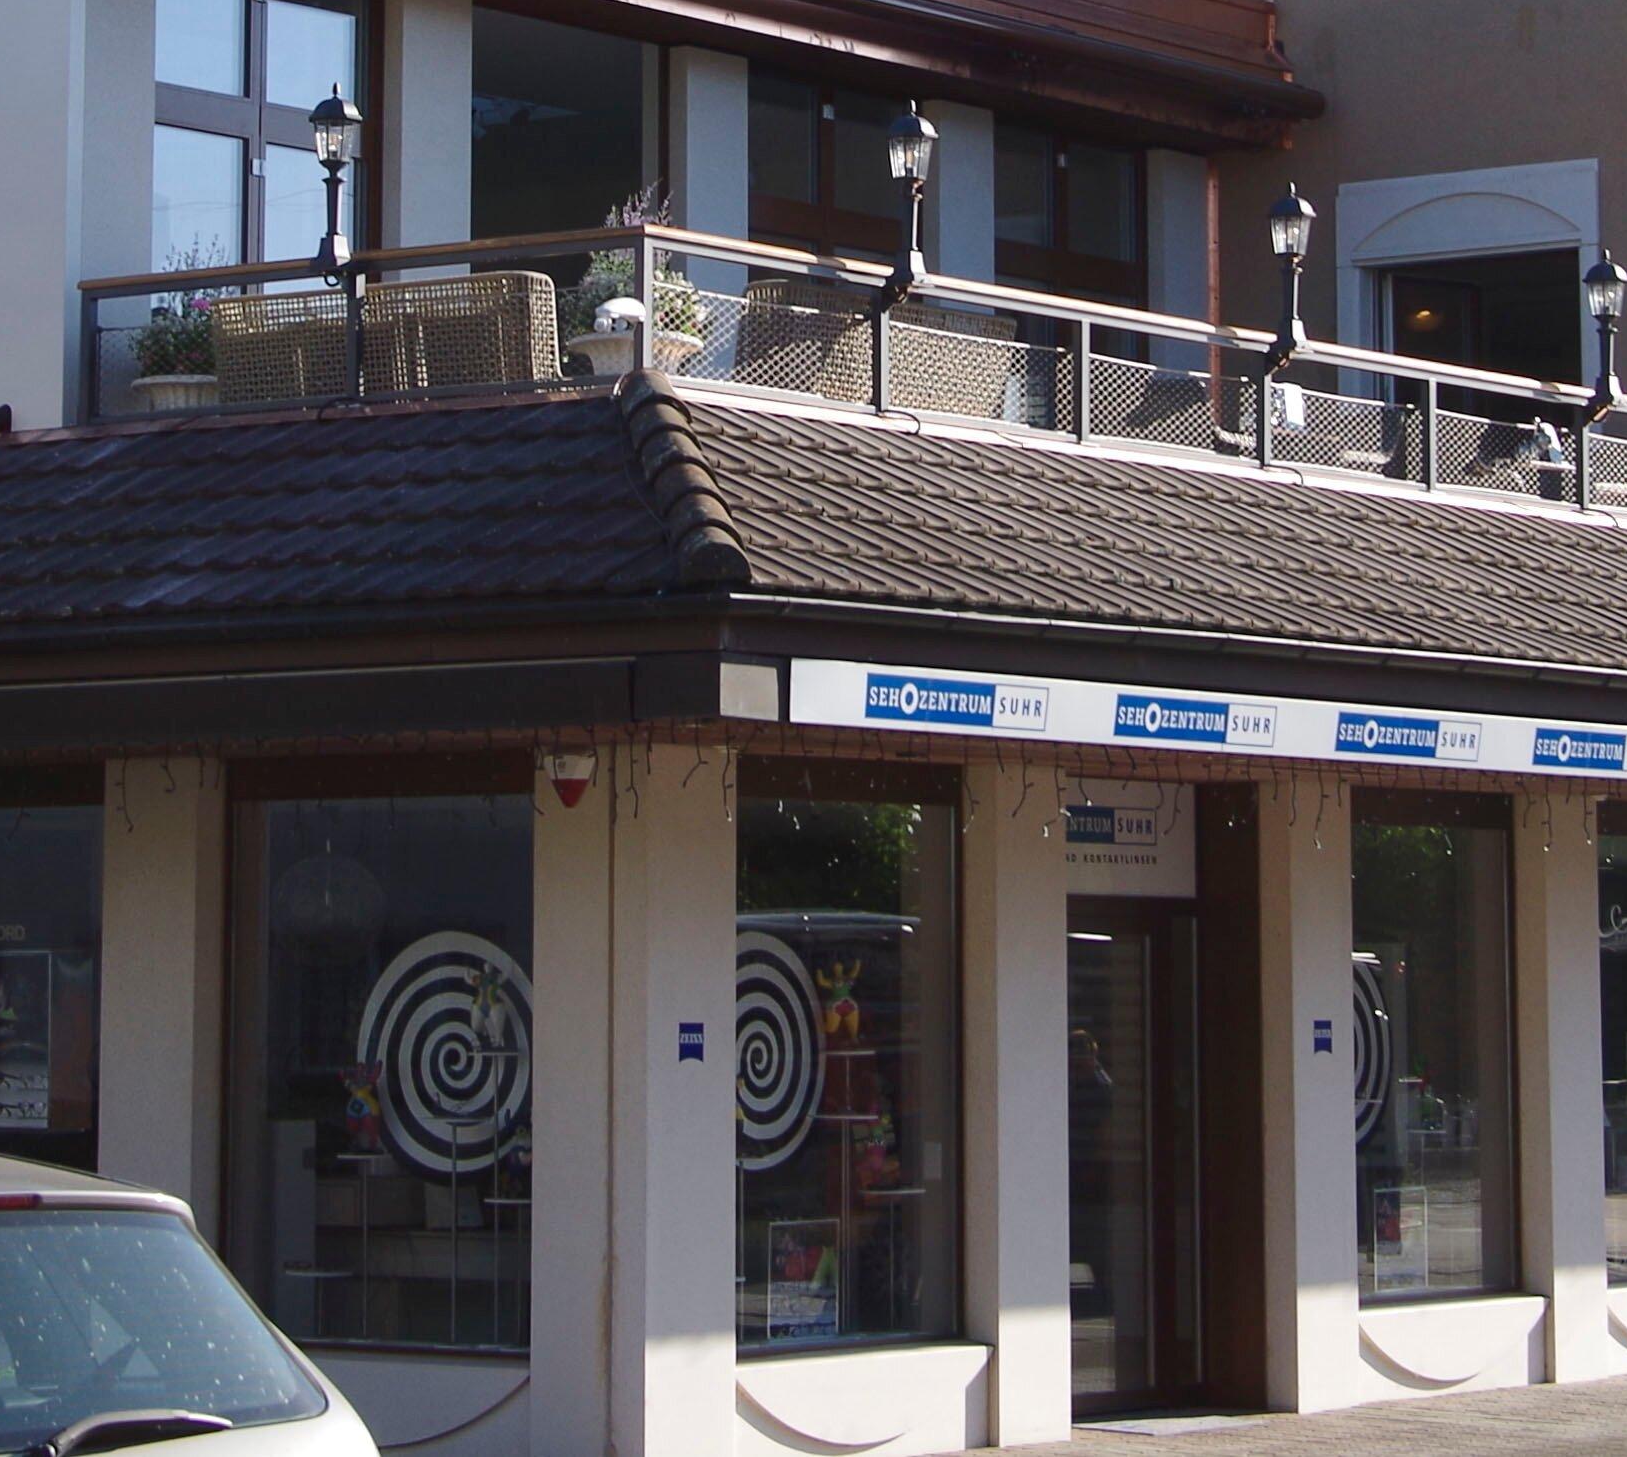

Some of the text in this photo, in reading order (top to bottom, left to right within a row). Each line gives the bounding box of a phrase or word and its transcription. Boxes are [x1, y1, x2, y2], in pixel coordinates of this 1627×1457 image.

[999, 696, 1042, 717] SUHR
[1231, 715, 1271, 734] SUHR
[1441, 731, 1476, 749] SUHR
[1117, 816, 1154, 835] SUHR
